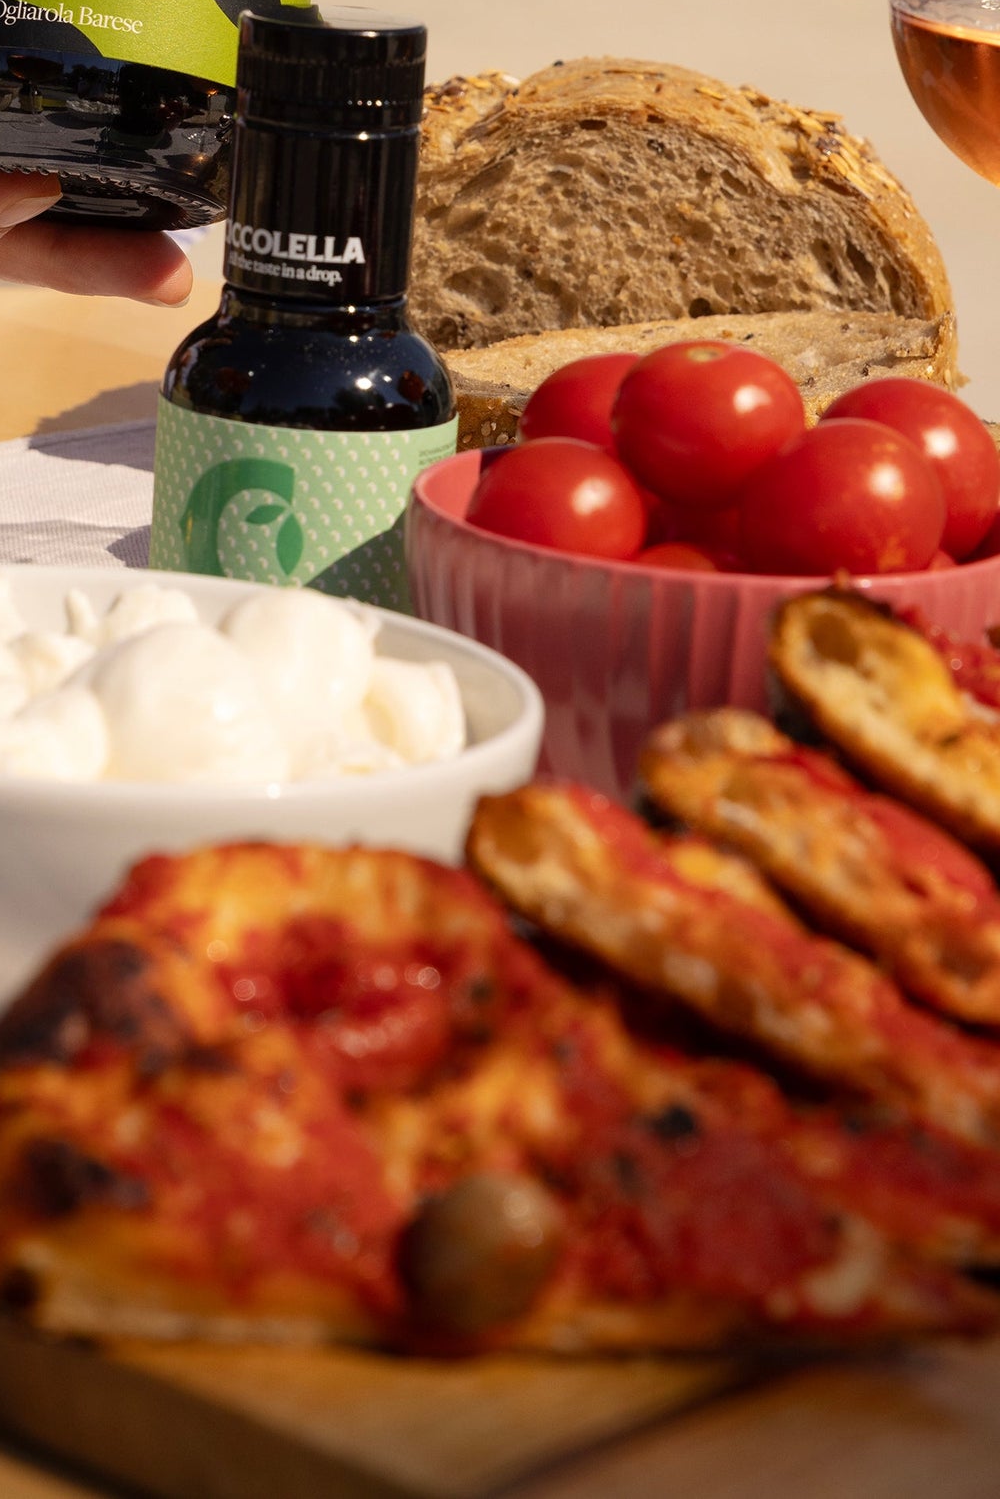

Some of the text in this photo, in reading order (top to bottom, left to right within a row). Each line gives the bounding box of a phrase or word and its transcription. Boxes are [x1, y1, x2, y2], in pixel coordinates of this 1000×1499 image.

[78, 6, 144, 35] Barese
[253, 260, 281, 277] taste
[281, 262, 295, 279] in
[295, 267, 305, 280] a
[305, 265, 343, 287] drop.
